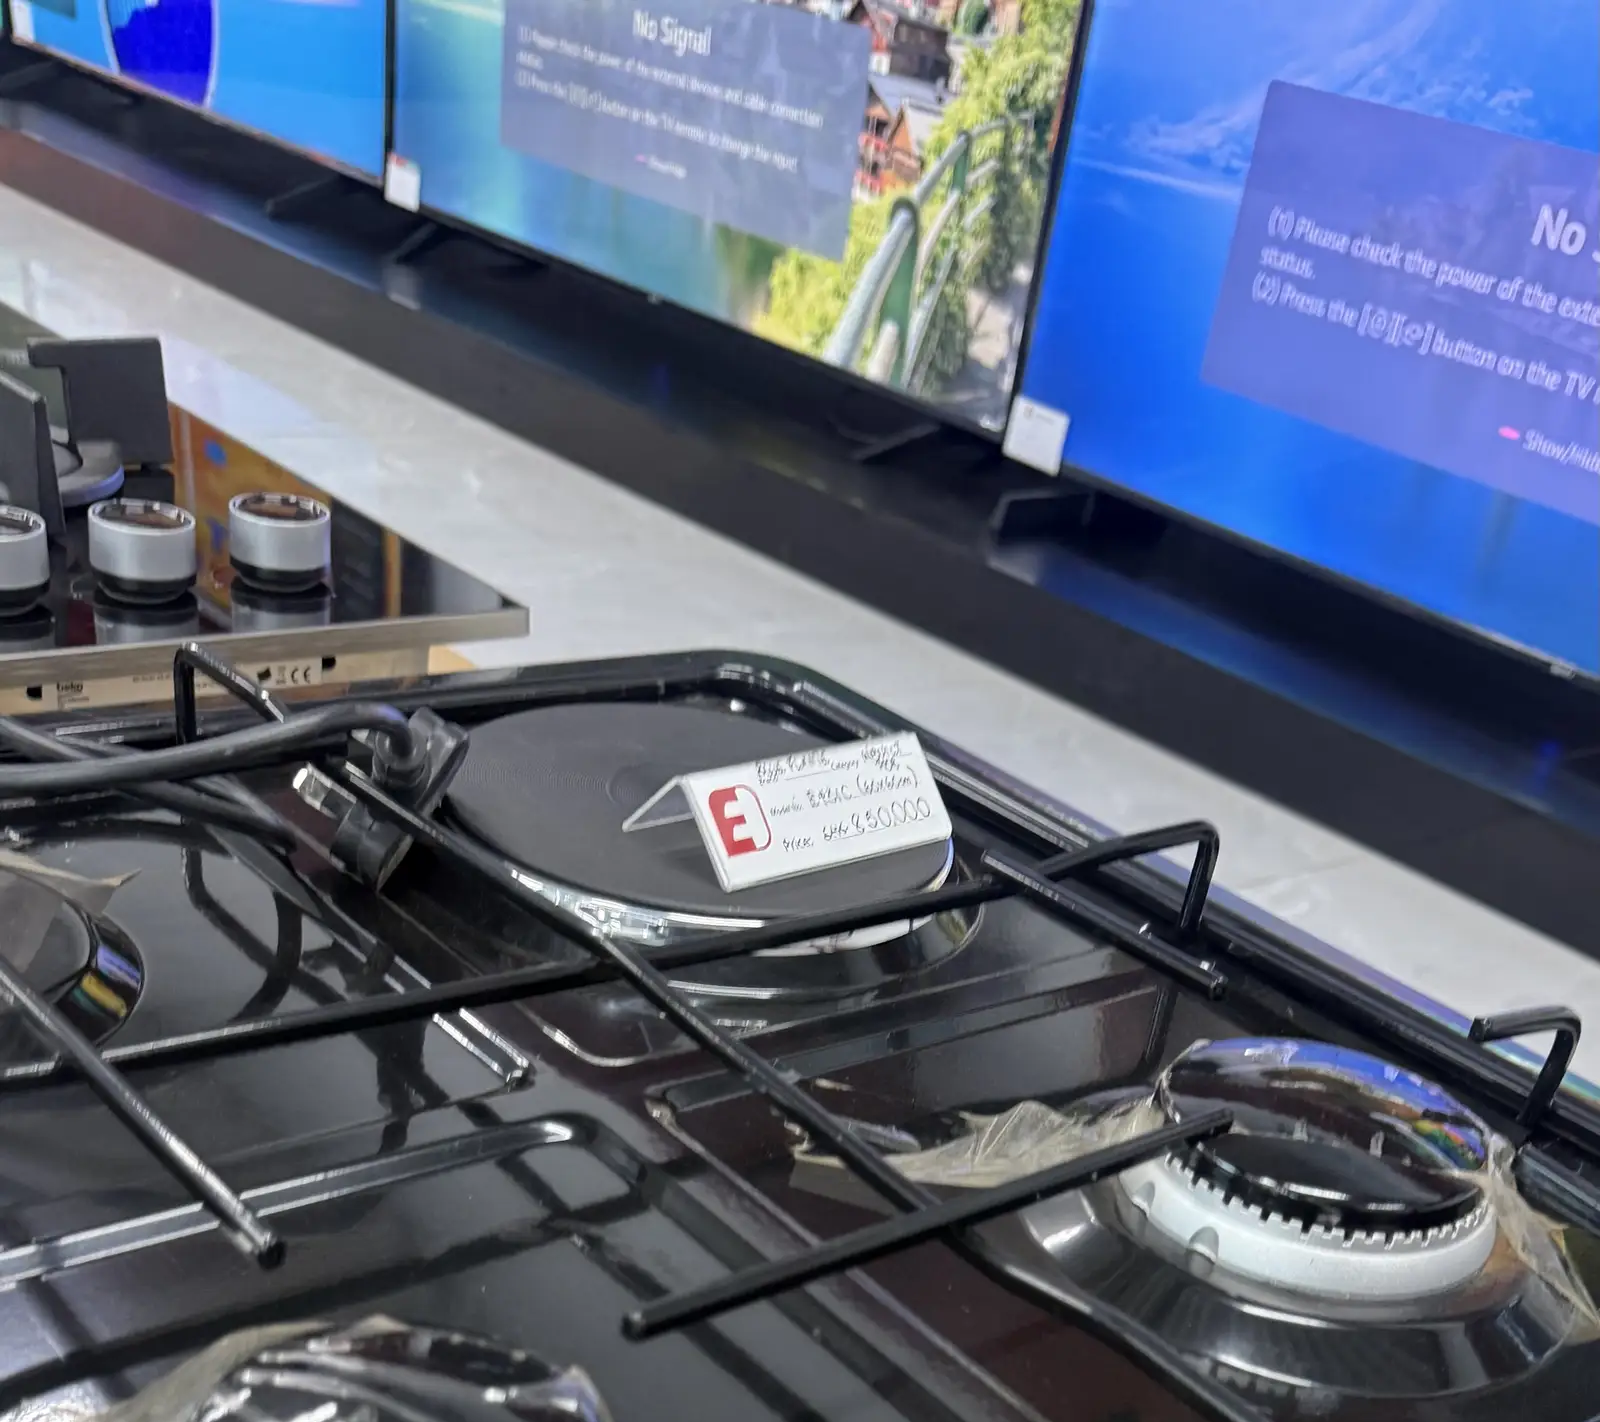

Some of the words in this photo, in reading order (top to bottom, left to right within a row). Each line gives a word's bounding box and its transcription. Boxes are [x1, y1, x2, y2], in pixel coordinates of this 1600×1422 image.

[660, 16, 712, 57] Signal
[1293, 215, 1350, 254] Please
[1350, 234, 1404, 269] check
[1404, 248, 1437, 280] the
[1435, 261, 1498, 295] power
[1496, 275, 1525, 303] of
[1522, 281, 1558, 314] the
[1531, 203, 1587, 256] No
[1280, 281, 1328, 319] Press
[1327, 298, 1360, 328] the
[1432, 328, 1498, 371] button
[1497, 355, 1526, 380] on
[1526, 360, 1562, 392] the
[1564, 370, 1597, 400] TV
